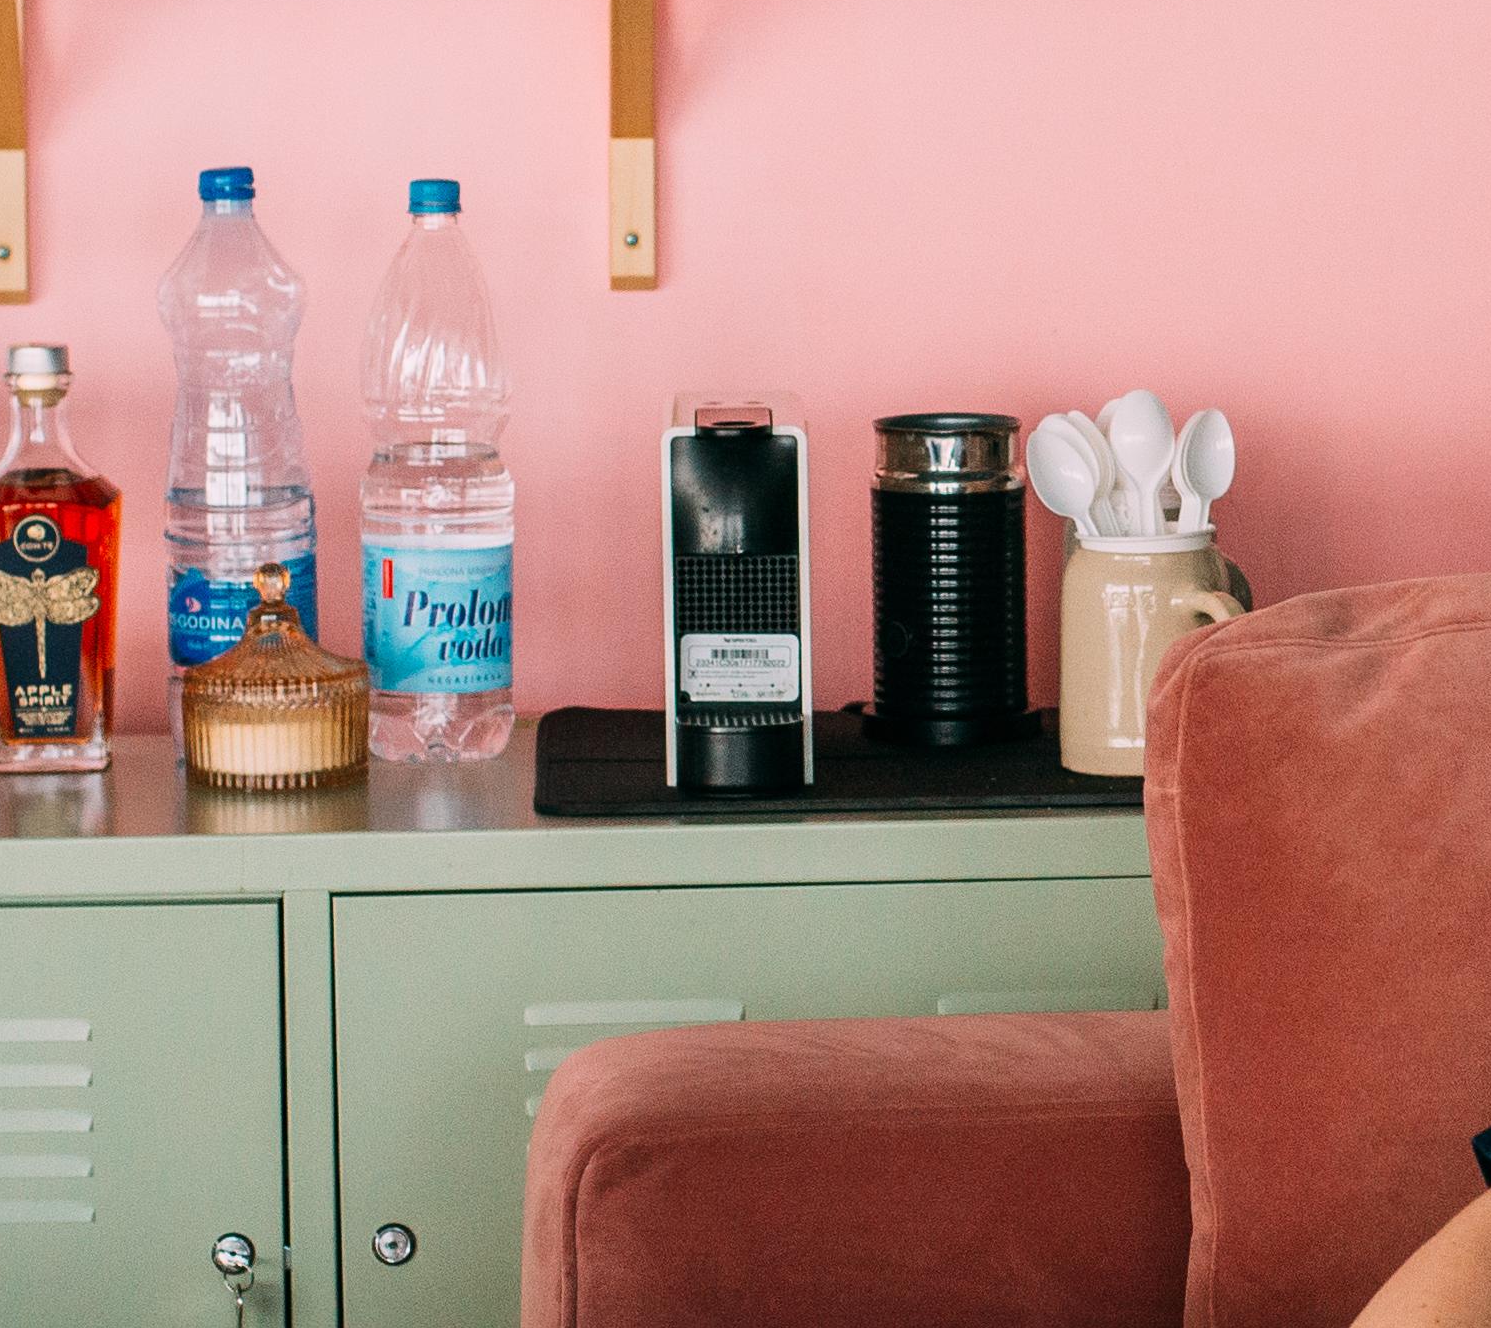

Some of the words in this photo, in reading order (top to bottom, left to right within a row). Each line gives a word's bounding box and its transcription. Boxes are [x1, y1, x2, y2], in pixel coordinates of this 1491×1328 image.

[438, 628, 503, 662] voda
[15, 683, 72, 697] APPLE
[18, 695, 69, 706] SPIRIT
